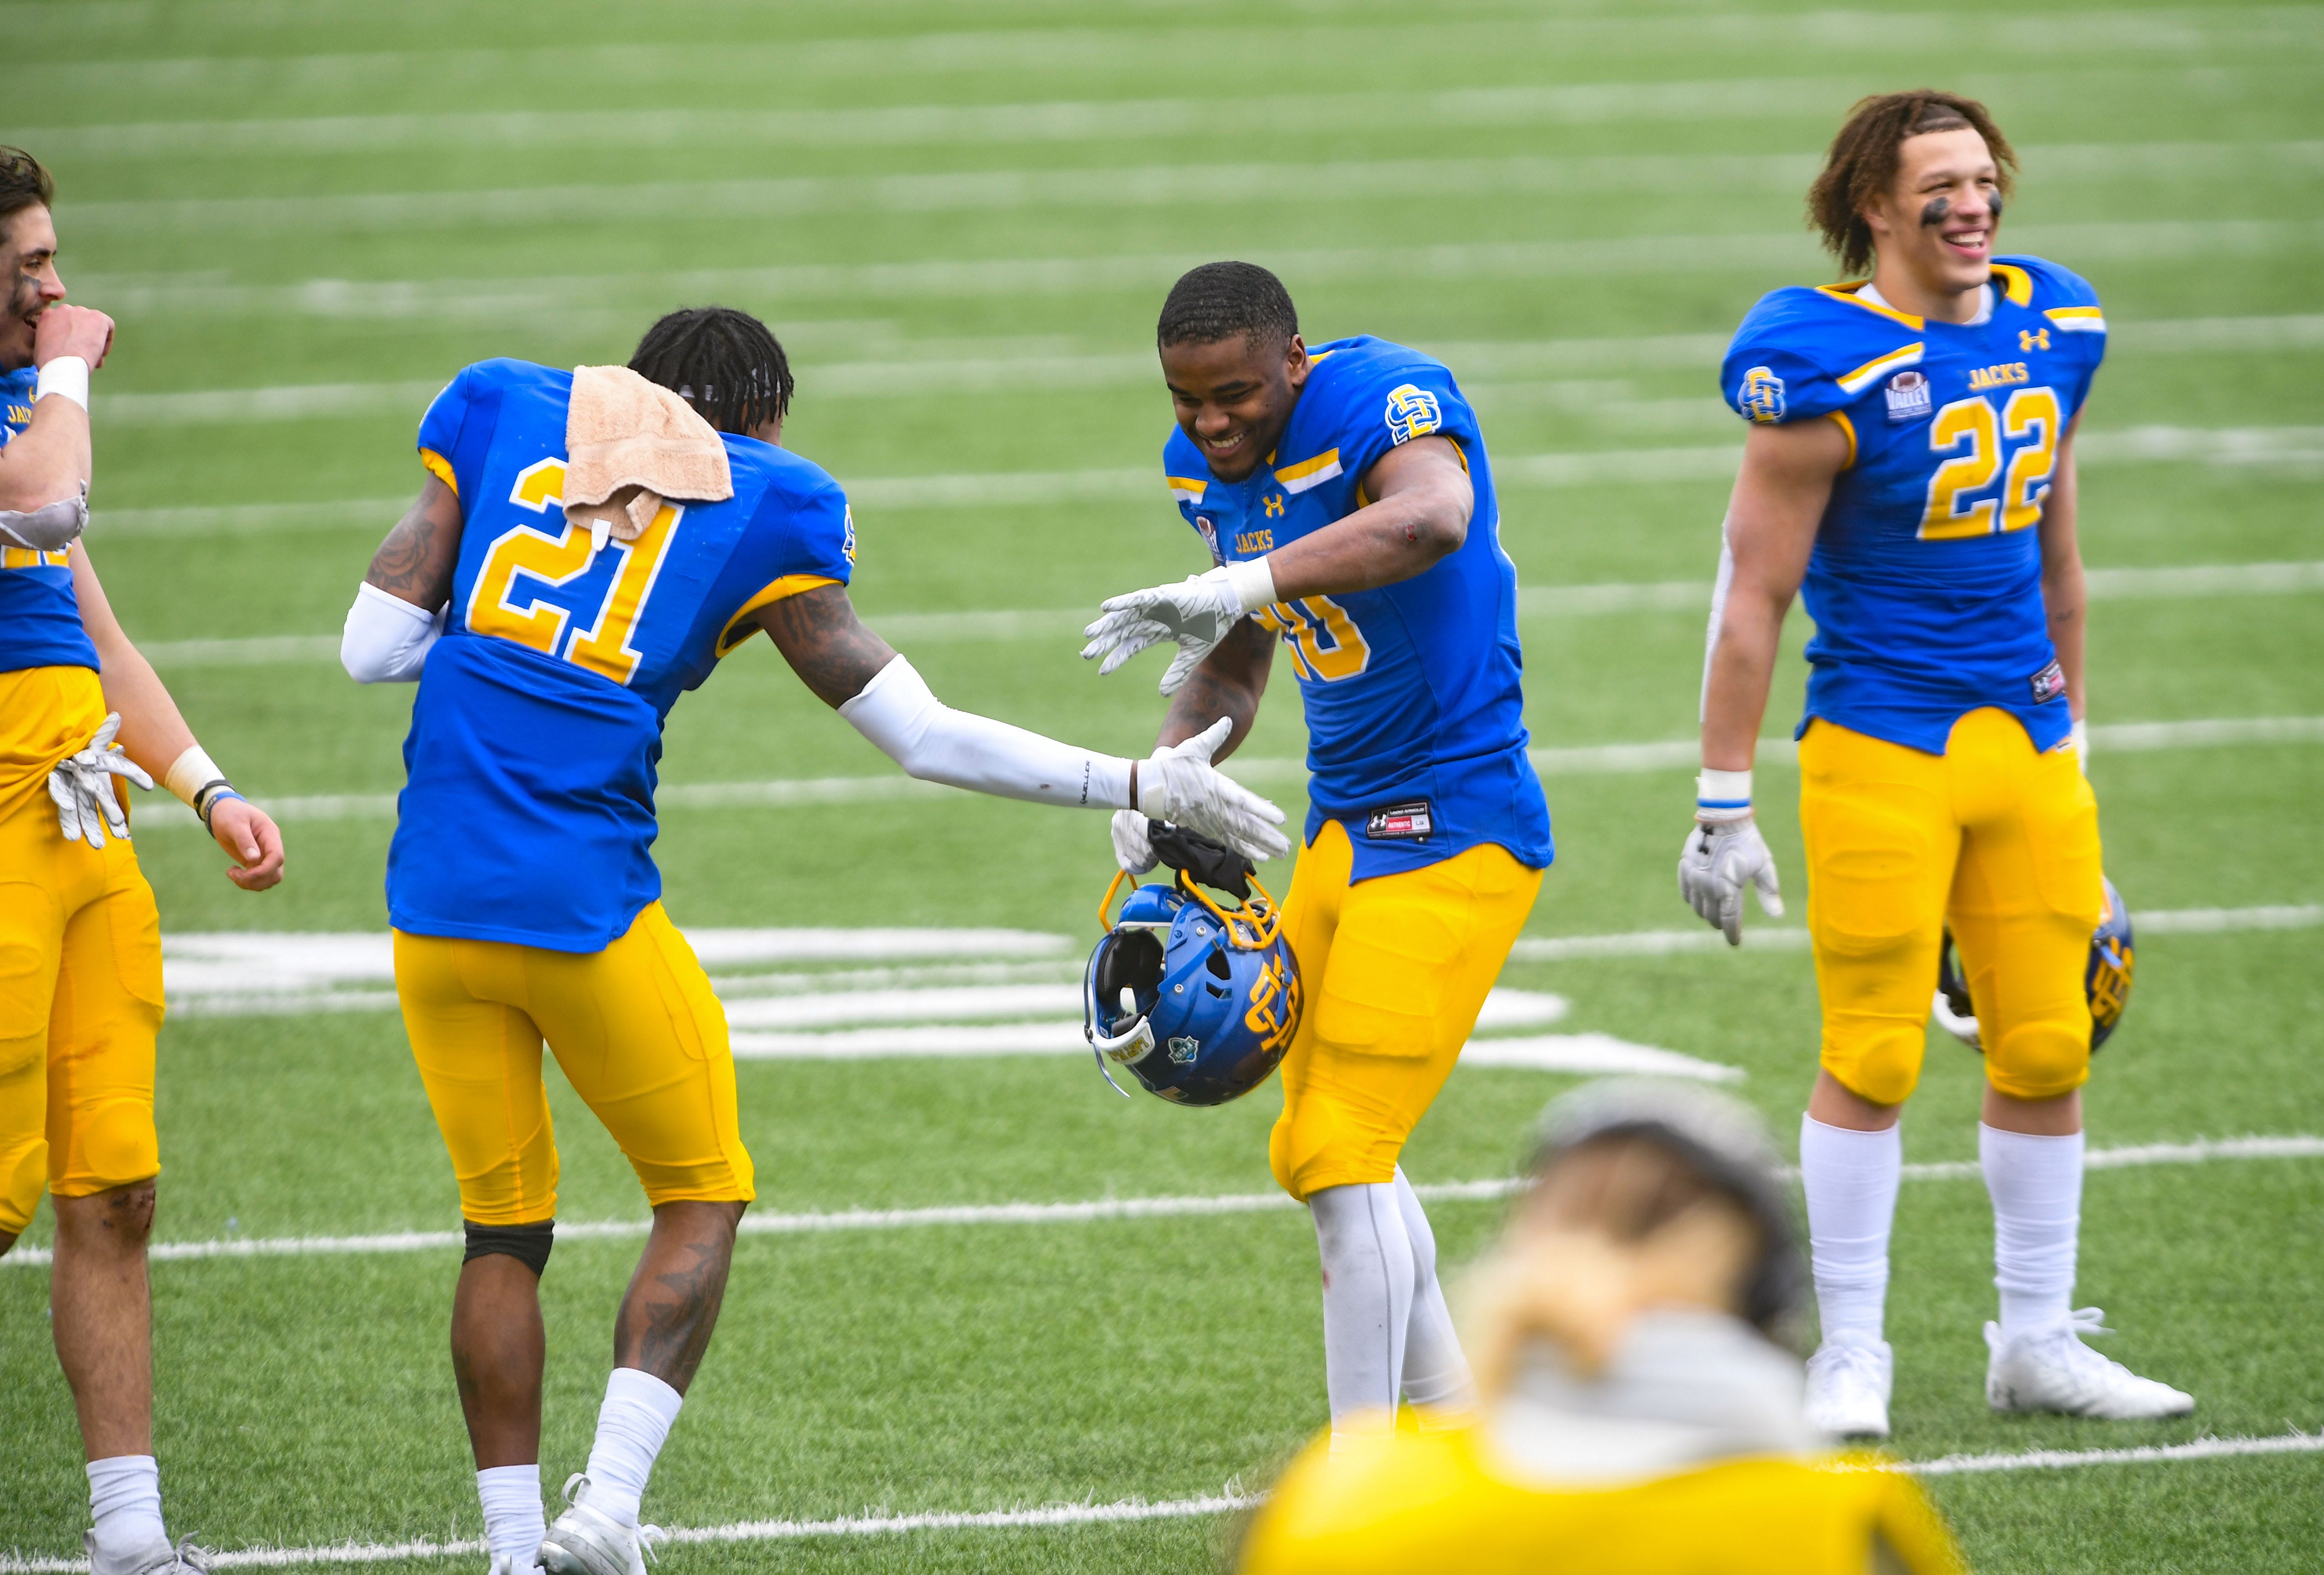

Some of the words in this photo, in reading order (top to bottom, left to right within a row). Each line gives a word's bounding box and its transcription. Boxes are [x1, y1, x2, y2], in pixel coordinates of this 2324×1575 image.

[1968, 362, 2030, 391] JACKS
[7, 405, 32, 424] JAC
[1915, 385, 2061, 541] 22
[1235, 529, 1274, 553] JACKS
[465, 456, 685, 687] 21
[1082, 760, 1090, 801] MUELLER
